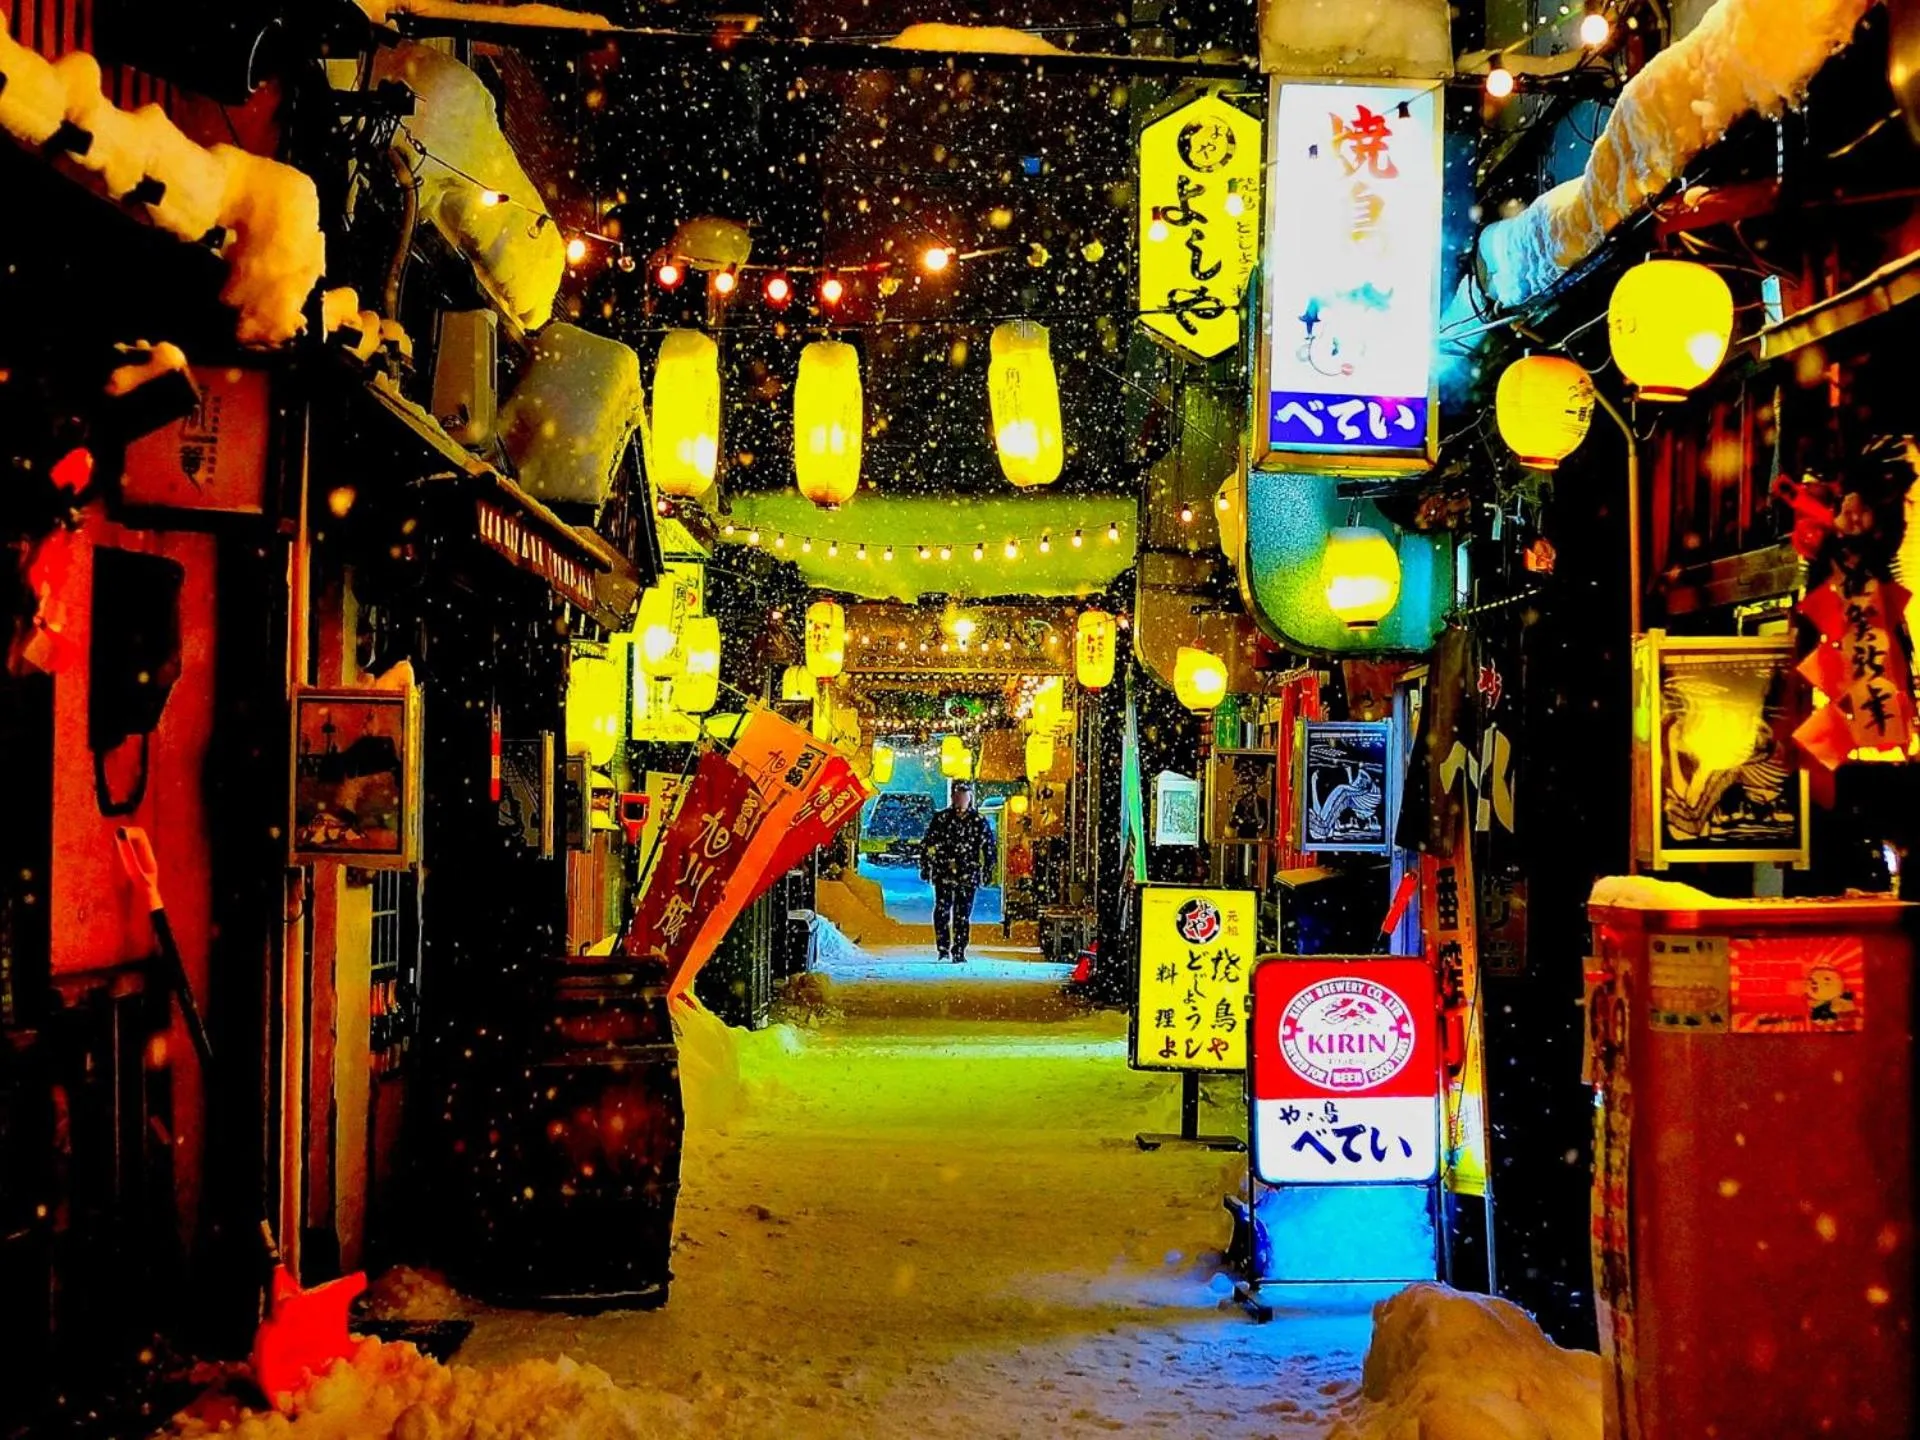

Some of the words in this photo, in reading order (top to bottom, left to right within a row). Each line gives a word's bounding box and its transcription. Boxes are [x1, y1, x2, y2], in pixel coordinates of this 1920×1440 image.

[1161, 175, 1225, 335] よしや
[1273, 398, 1416, 440] べてい
[1155, 962, 1178, 1029] 料理
[1316, 981, 1364, 998] BREWERY
[1158, 1035, 1229, 1061] よしや
[1308, 1033, 1386, 1054] KIRIN
[1290, 1123, 1413, 1166] べてい
